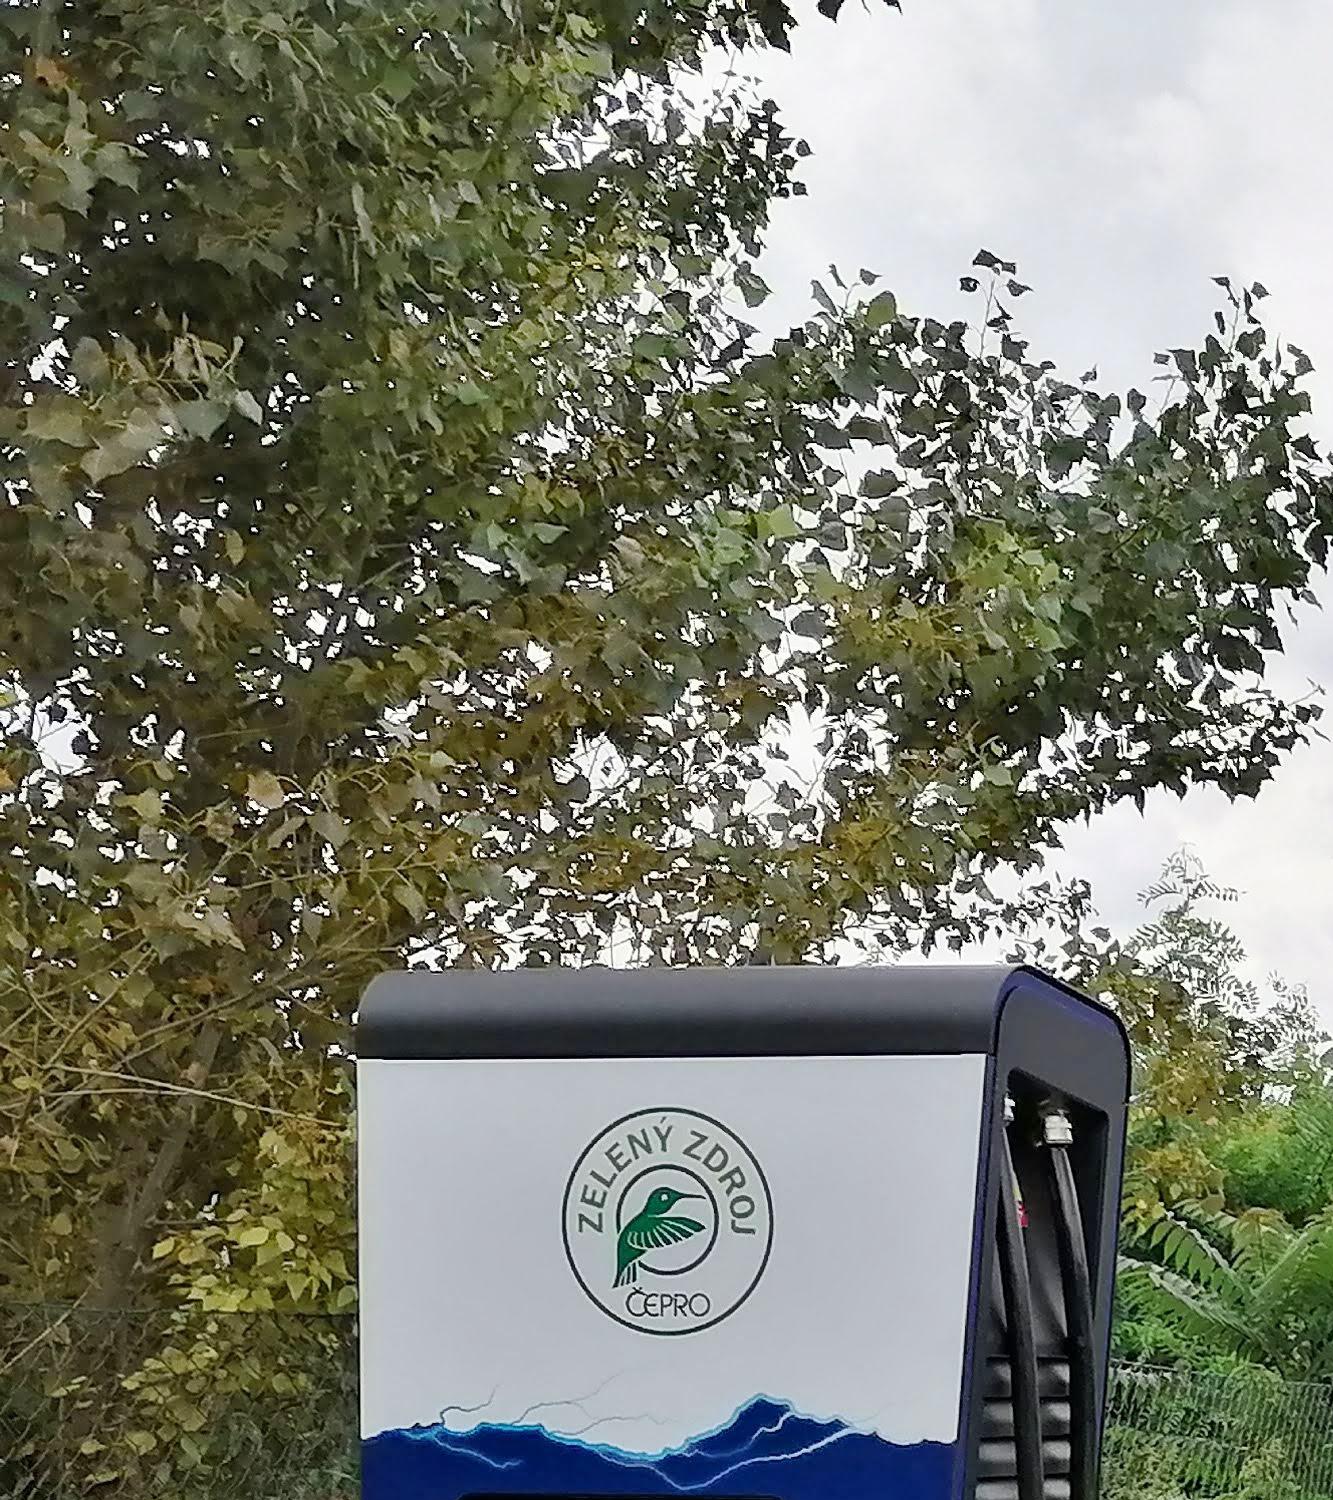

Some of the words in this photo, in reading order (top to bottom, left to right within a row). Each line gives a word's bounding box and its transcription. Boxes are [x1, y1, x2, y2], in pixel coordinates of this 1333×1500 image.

[576, 1116, 674, 1235] ZELENÝ
[683, 1129, 757, 1236] ZDROJ
[625, 1286, 712, 1319] ČEPRO
